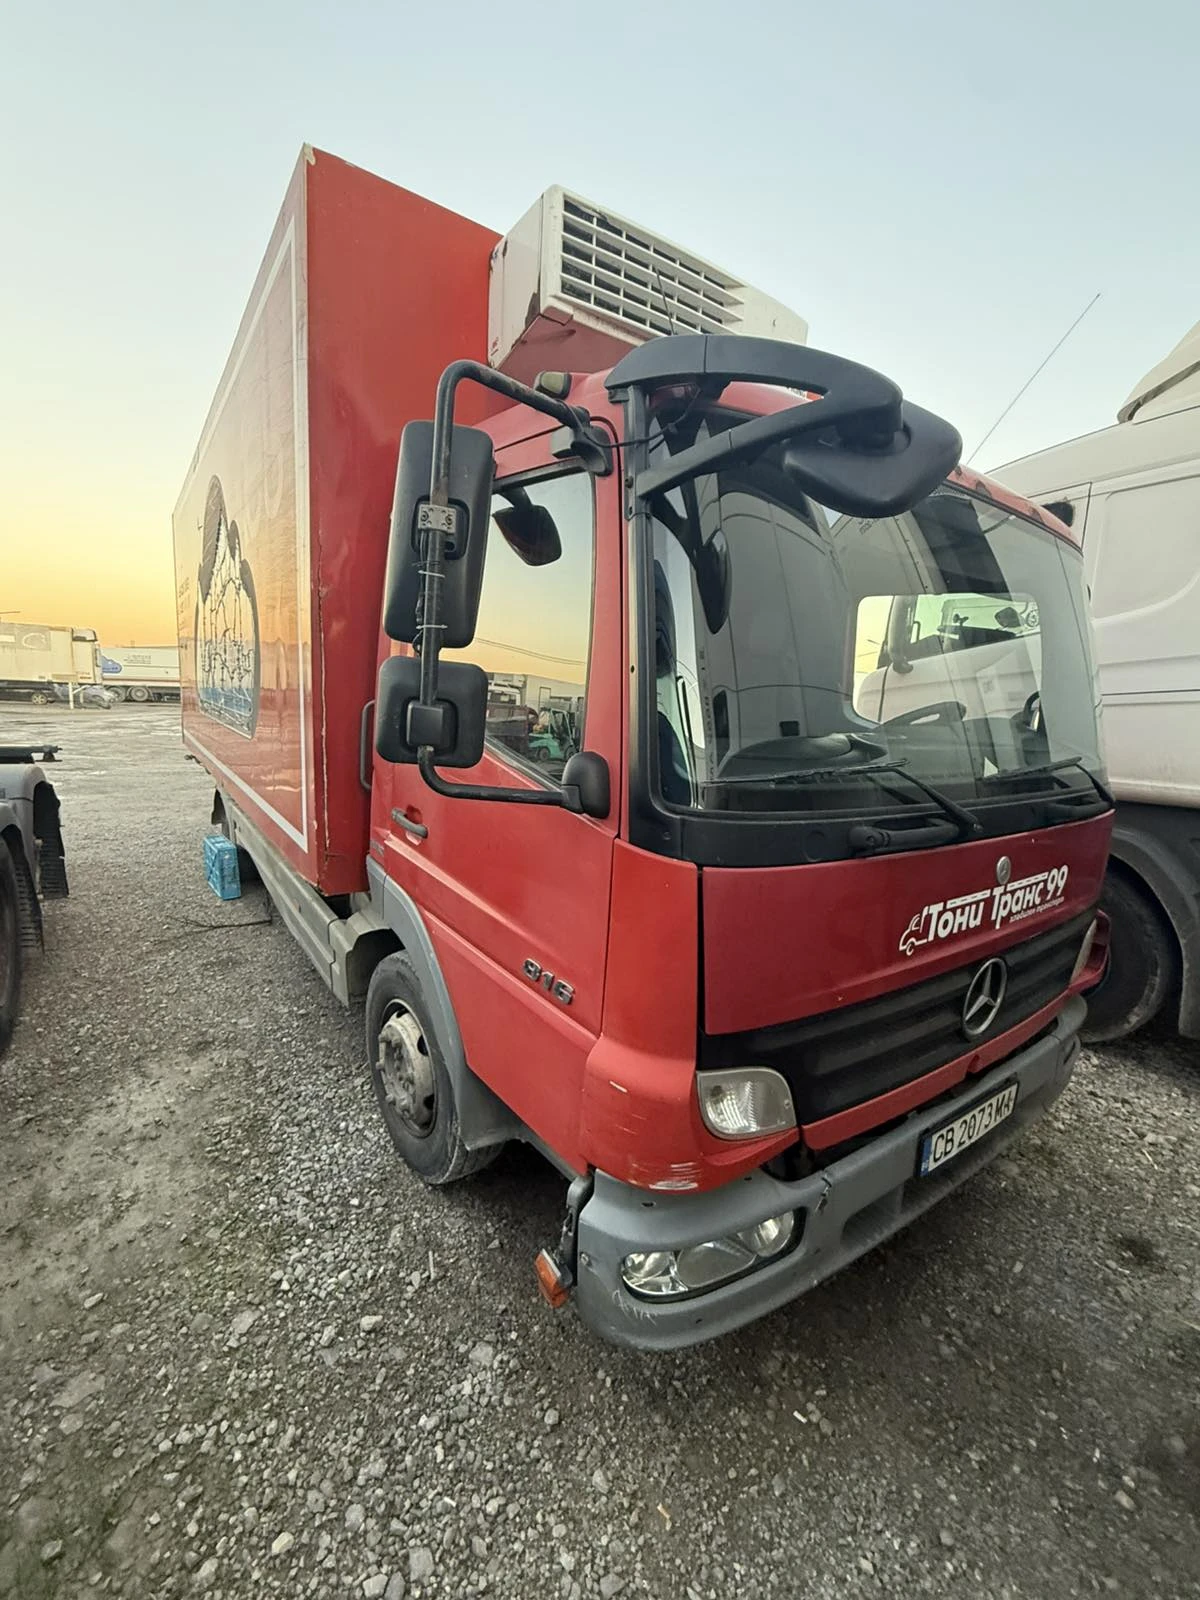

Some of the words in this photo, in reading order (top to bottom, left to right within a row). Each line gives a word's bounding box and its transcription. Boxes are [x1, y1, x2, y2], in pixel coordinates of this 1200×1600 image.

[927, 901, 985, 942] Тони
[991, 882, 1045, 930] Транс
[1047, 865, 1069, 900] 99
[523, 958, 575, 1005] 916
[933, 1126, 955, 1163] CB
[957, 1102, 993, 1148] 2073
